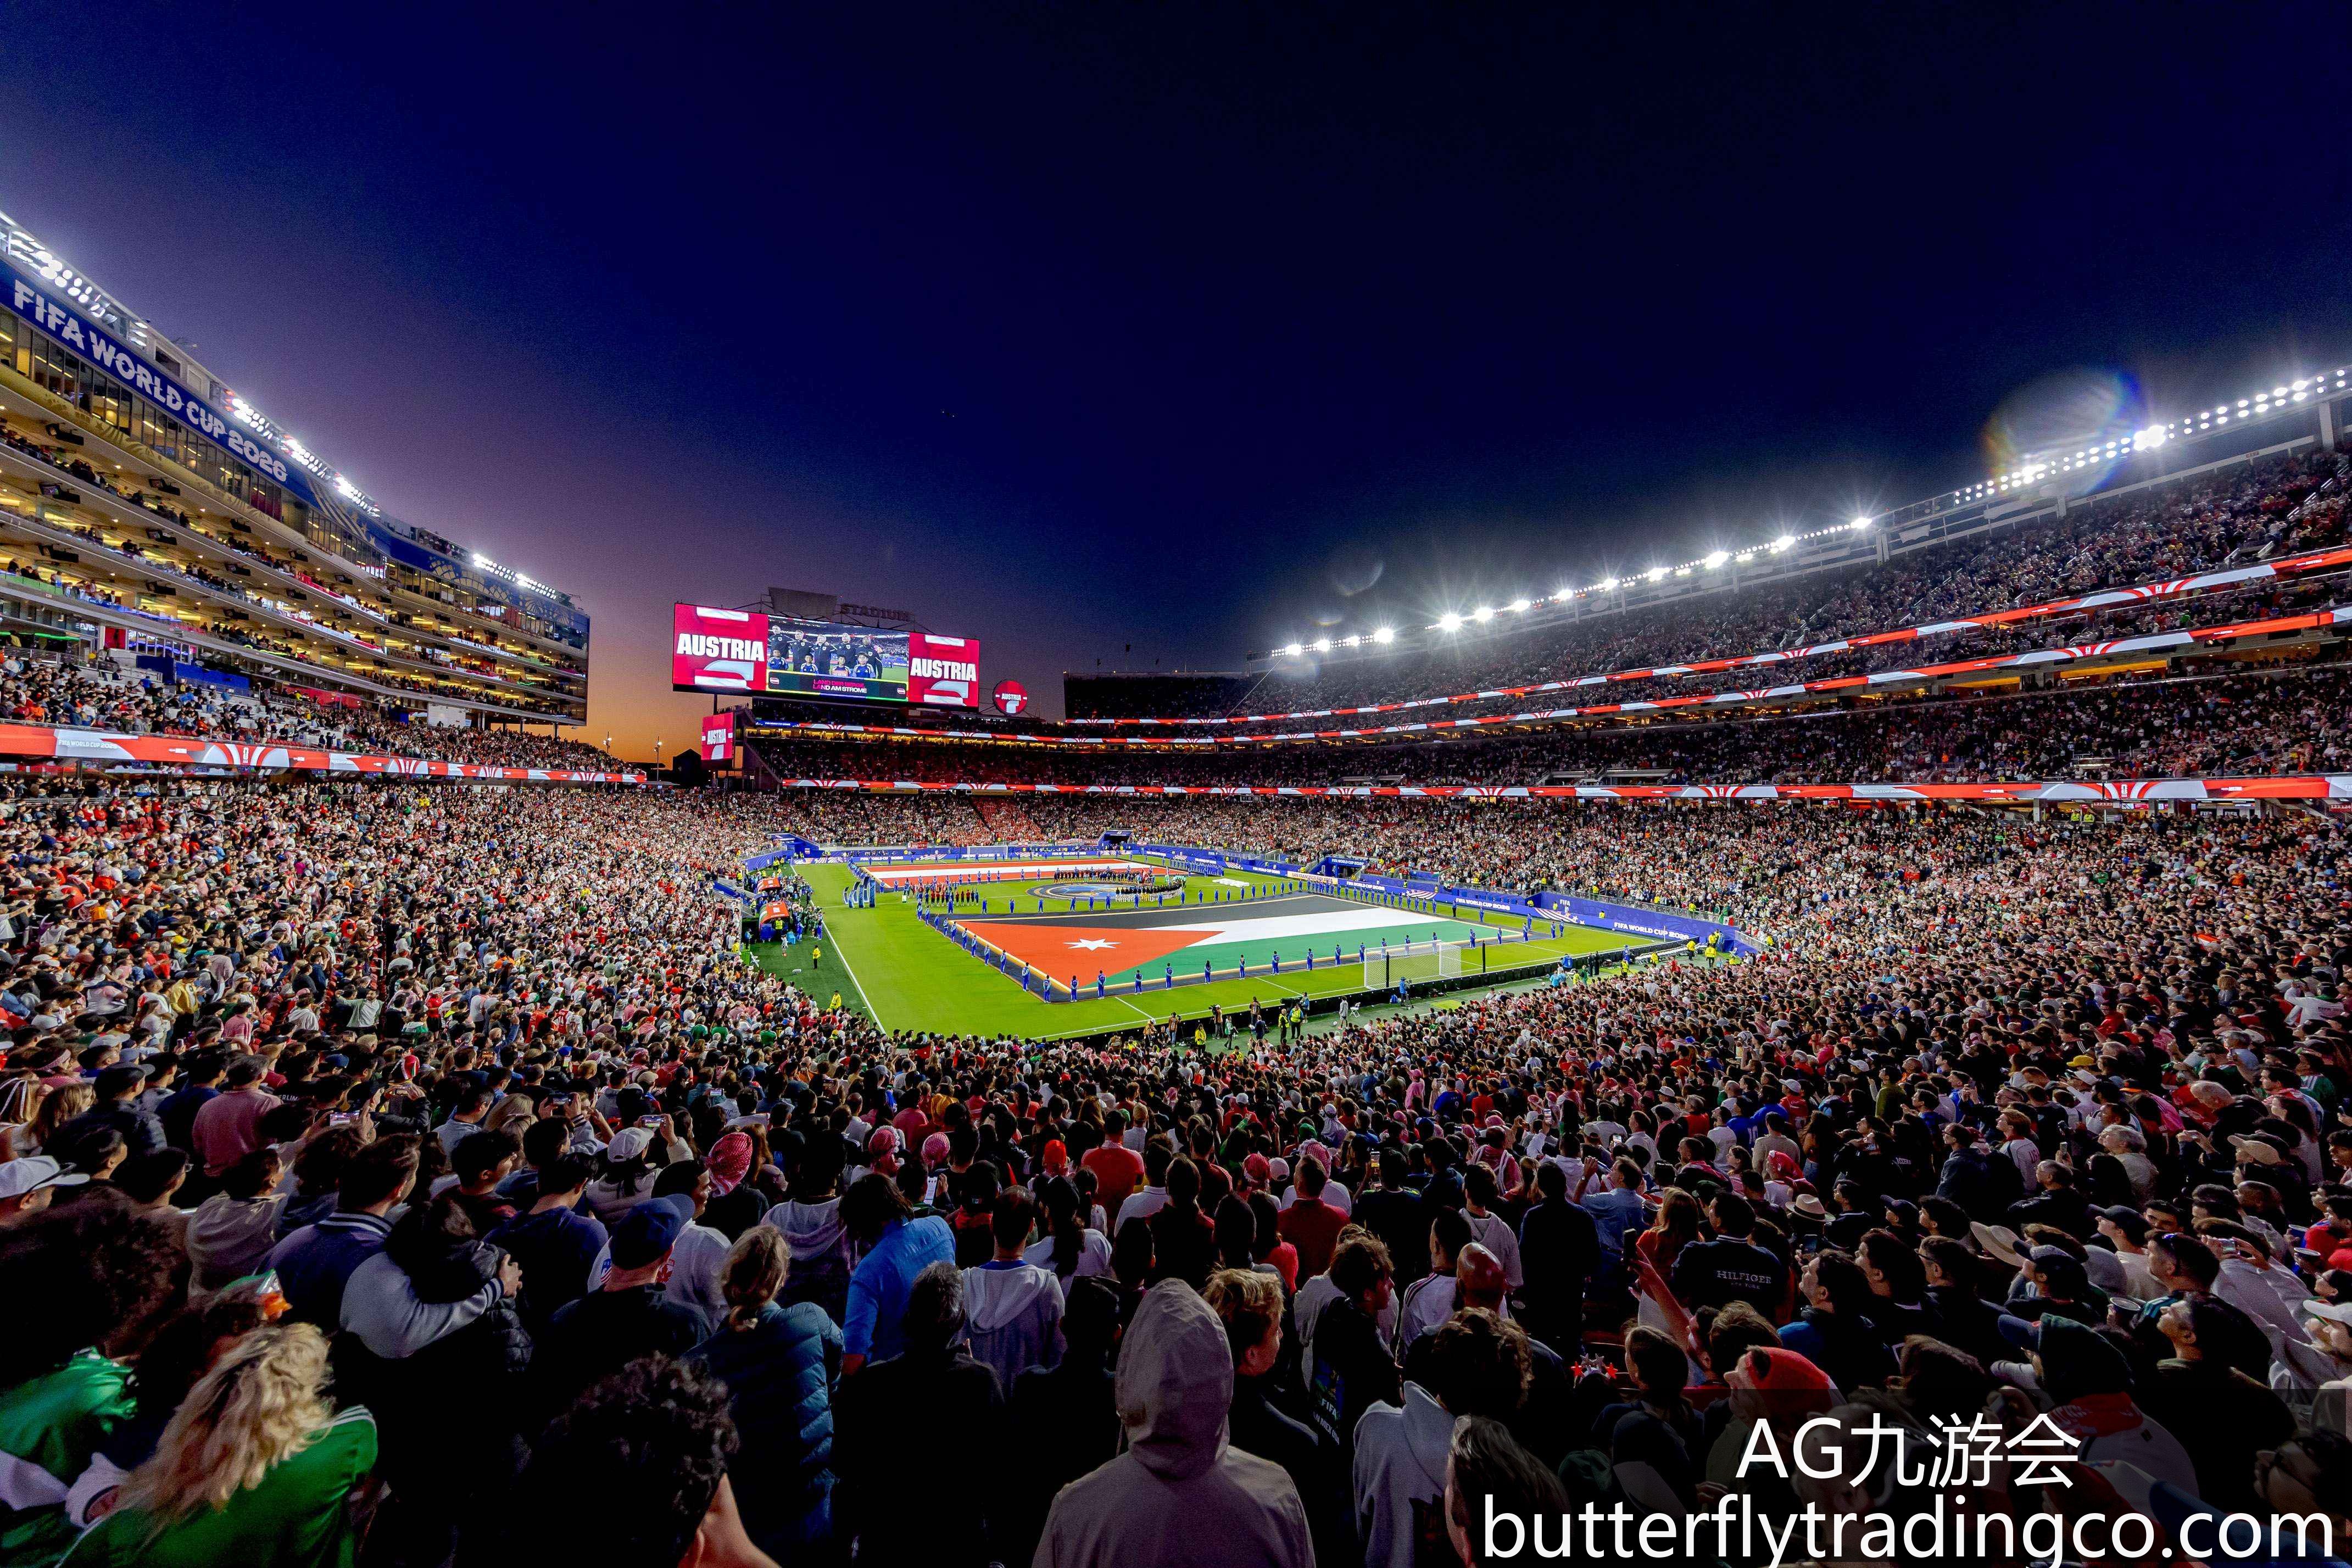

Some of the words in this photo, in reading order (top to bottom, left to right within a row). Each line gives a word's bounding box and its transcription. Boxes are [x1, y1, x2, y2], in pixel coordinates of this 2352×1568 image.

[14, 279, 85, 350] FIFA
[89, 330, 185, 411] WORLD
[186, 400, 228, 440] CUP
[228, 430, 287, 482] 2026
[840, 604, 911, 622] STADIUM
[677, 633, 765, 661] AUSTRIA
[910, 657, 977, 682] AUSTRIA
[707, 728, 726, 745] AUSTRIA
[1629, 924, 1653, 934] WORLD
[1716, 1270, 1771, 1284] HILFIGER
[1321, 1398, 1336, 1420] FIFA
